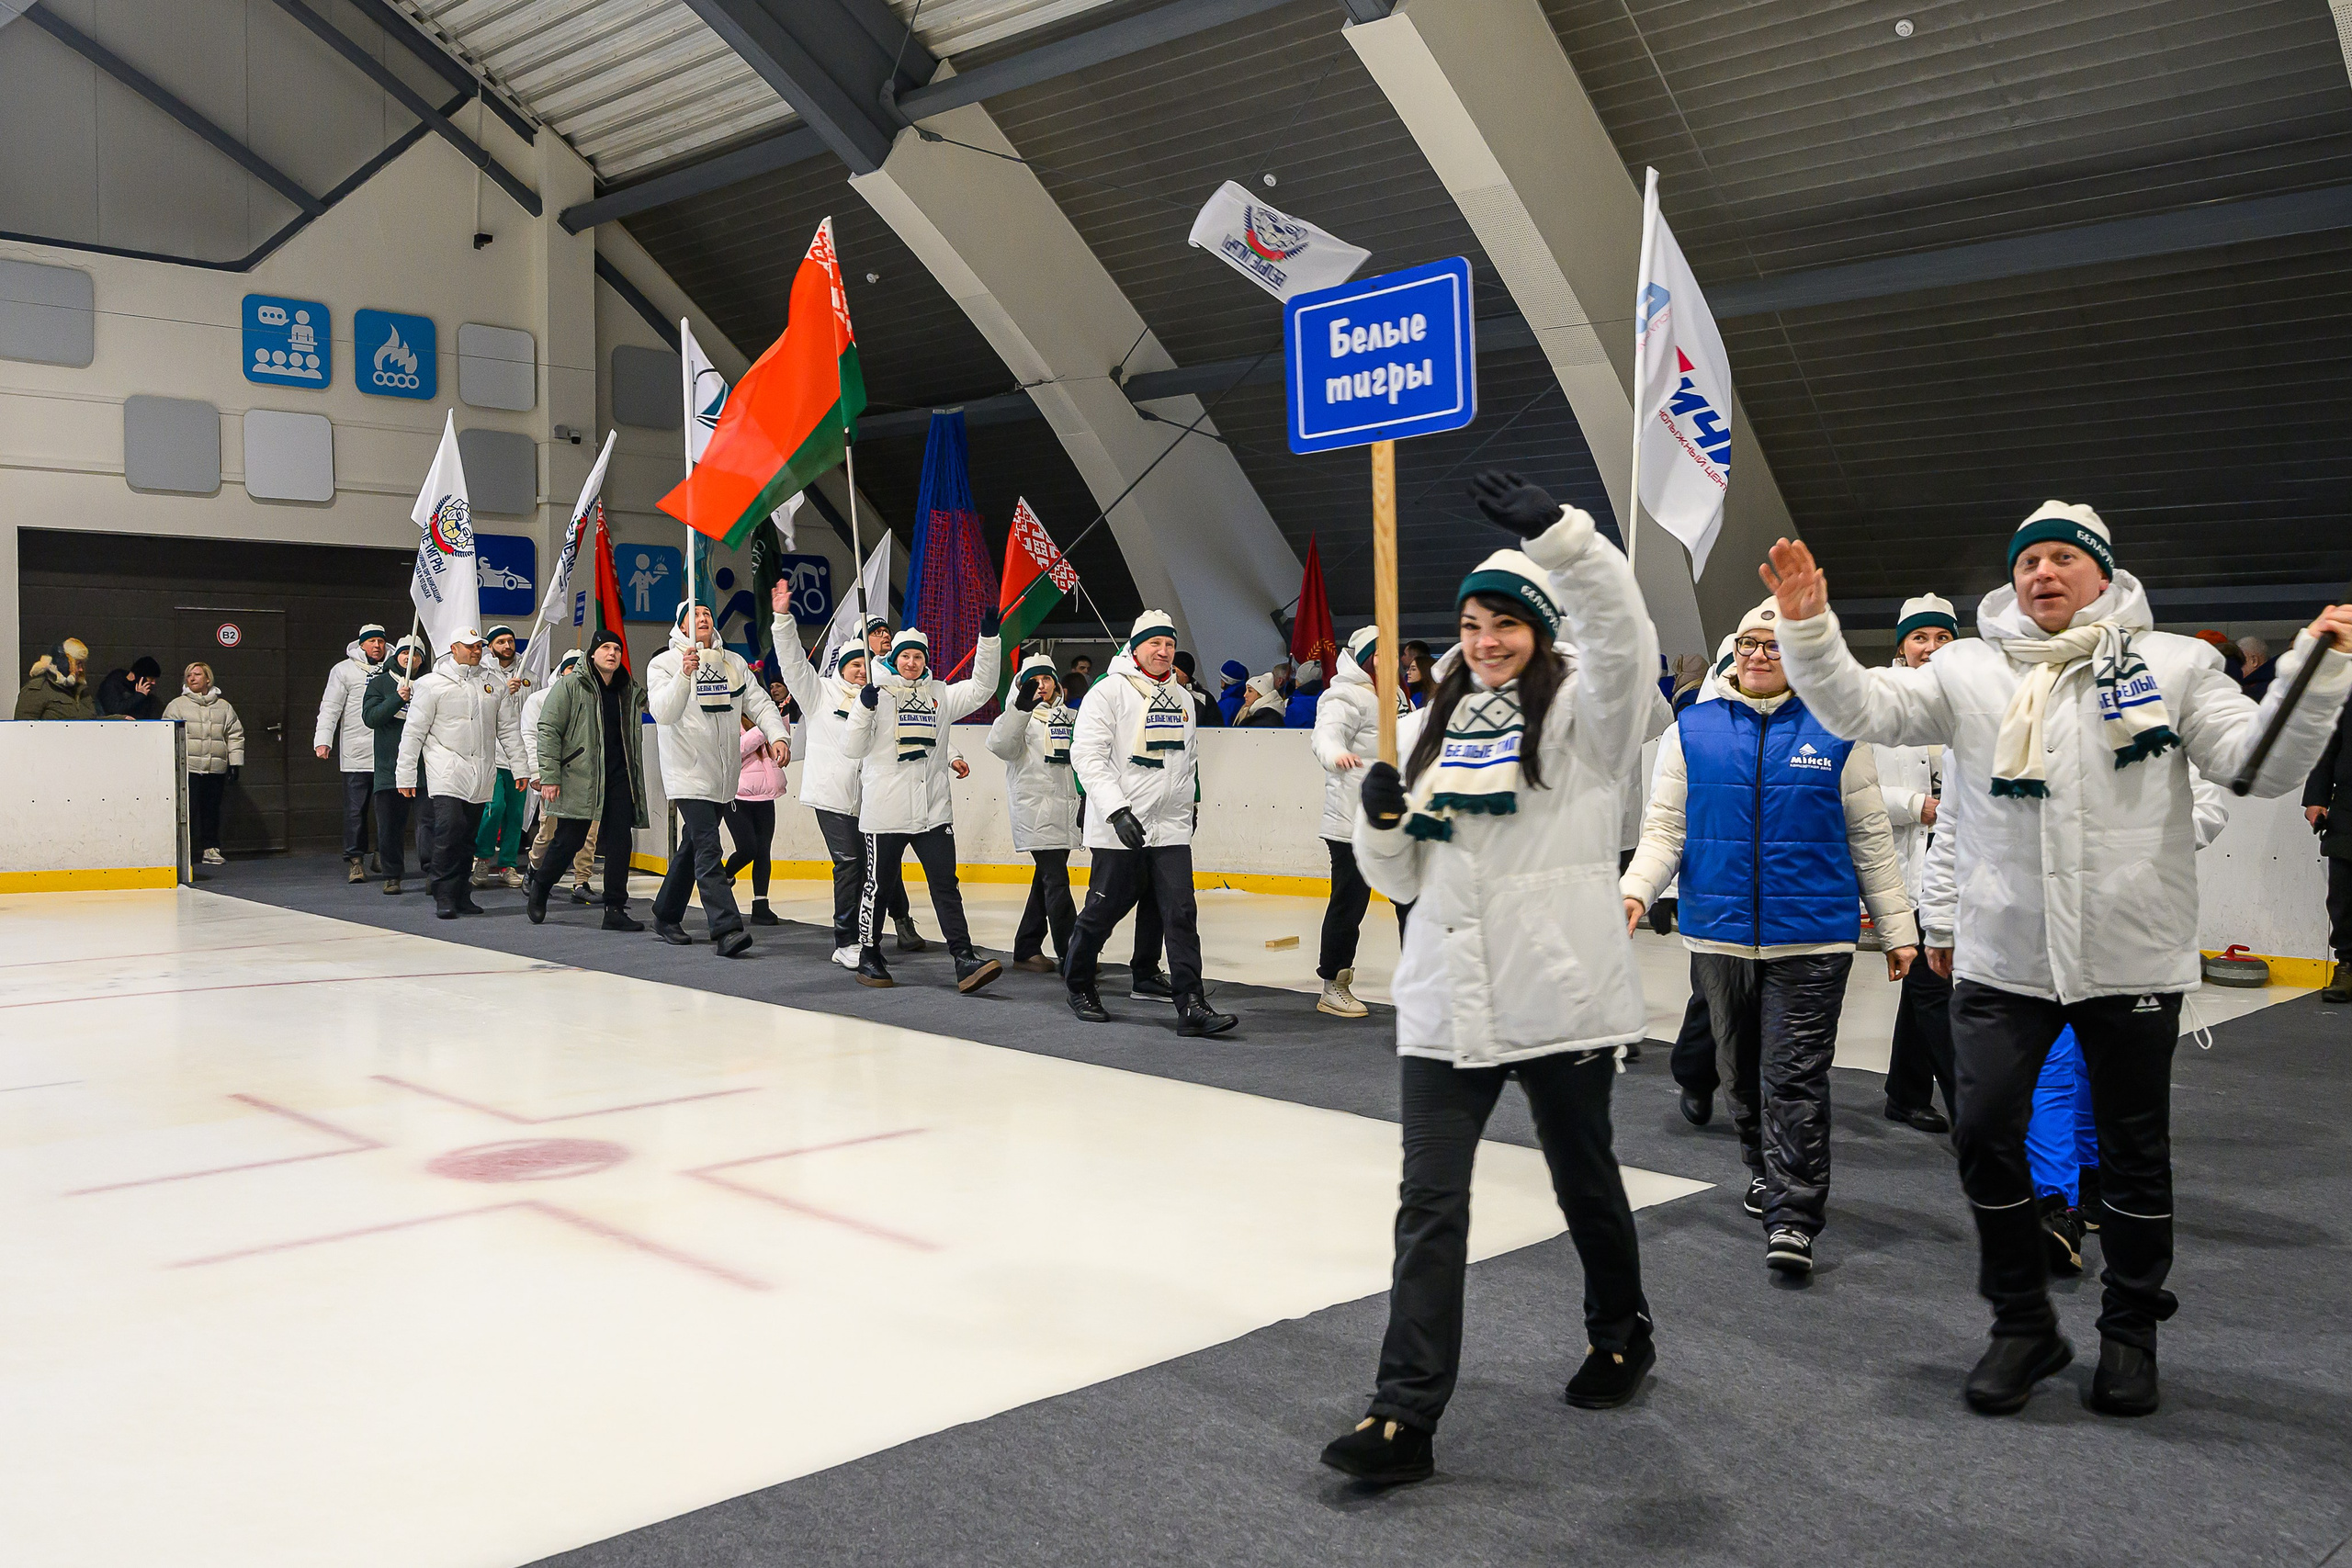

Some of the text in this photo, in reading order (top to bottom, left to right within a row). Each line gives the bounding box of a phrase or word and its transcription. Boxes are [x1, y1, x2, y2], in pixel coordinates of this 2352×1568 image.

[1329, 313, 1427, 358] Белые
[1326, 358, 1433, 404] тигры
[1444, 744, 1494, 759] БЕЛЫЕ
